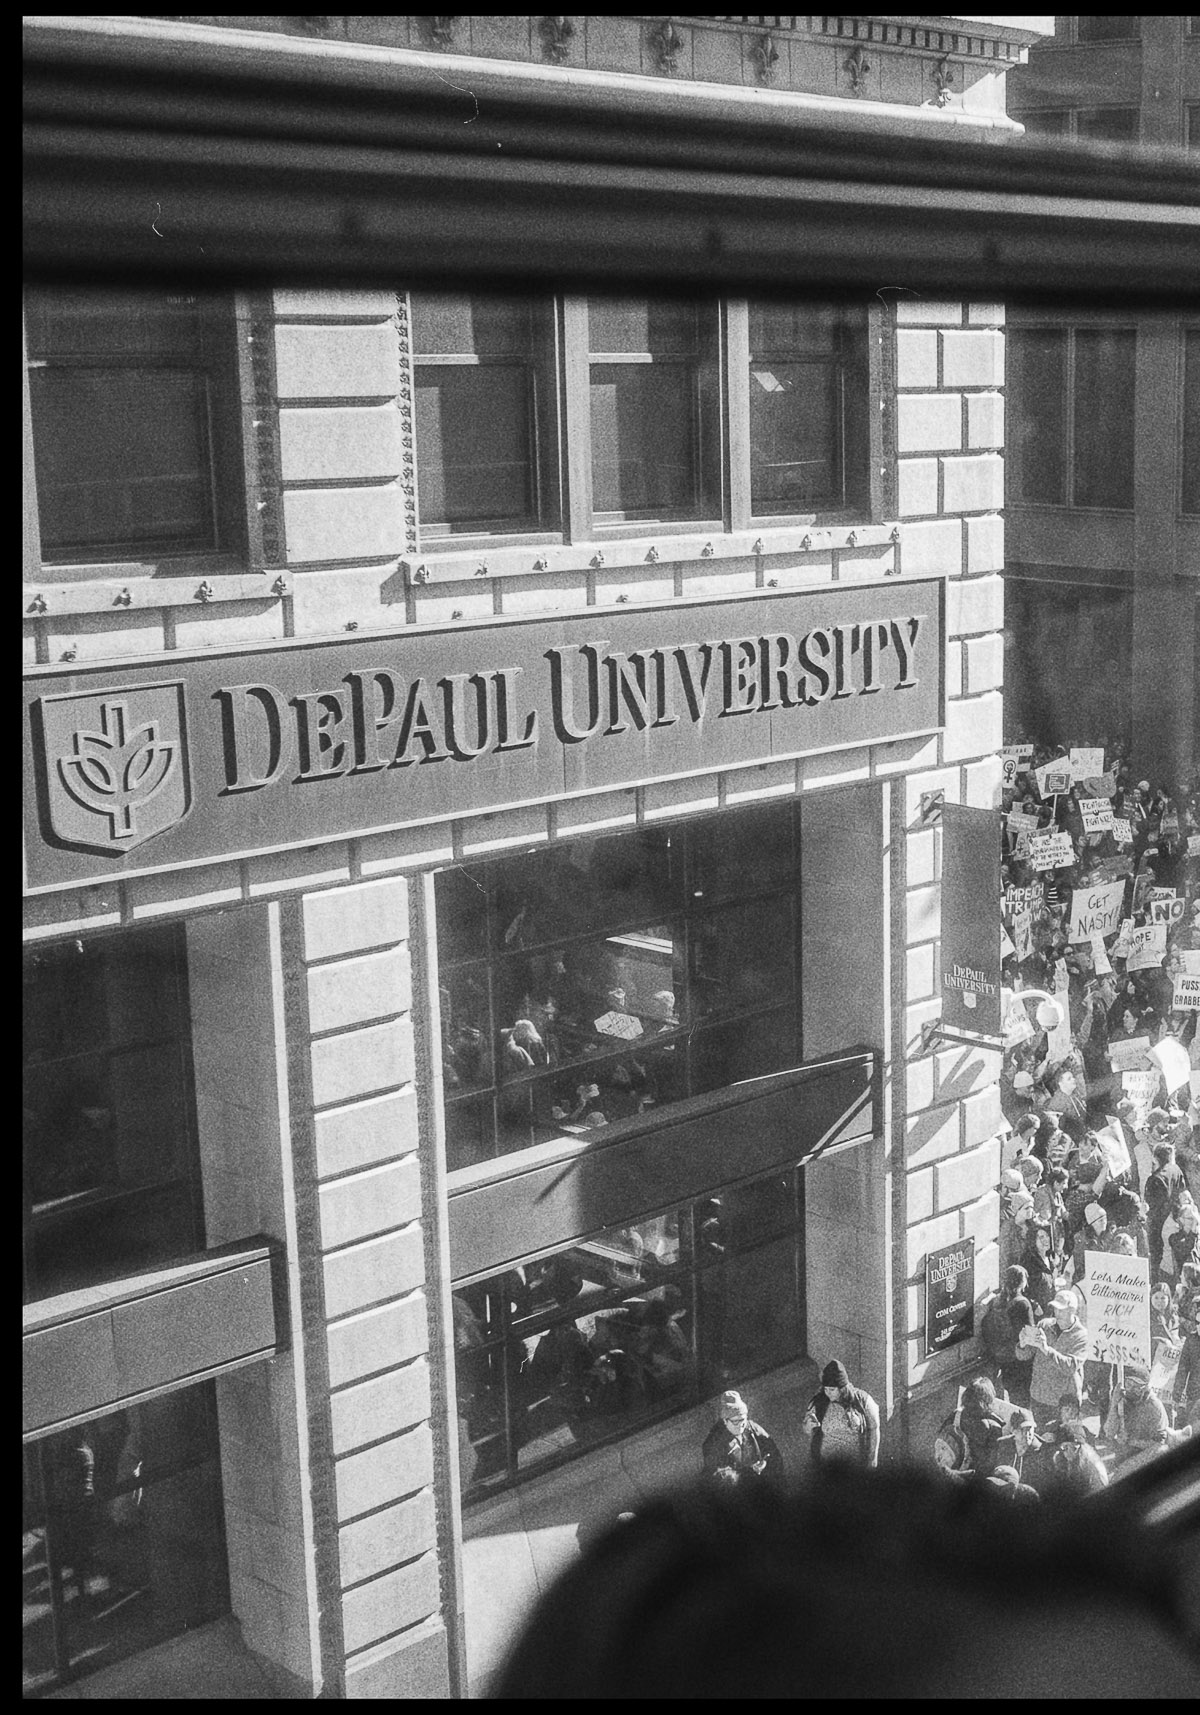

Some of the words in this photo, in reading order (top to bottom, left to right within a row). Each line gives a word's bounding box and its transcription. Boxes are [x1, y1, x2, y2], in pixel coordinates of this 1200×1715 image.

[544, 616, 924, 743] UNIVERSITY
[1007, 883, 1044, 901] IMPEACH
[1006, 897, 1042, 913] TRUMP
[1088, 894, 1110, 910] GET
[1155, 900, 1184, 921] NO
[1130, 931, 1151, 949] HOPE
[953, 964, 986, 983] DEPAUL
[944, 972, 996, 995] UNIVERSITY
[939, 1251, 964, 1269] DEPAUL
[931, 1257, 972, 1282] UNIVERSITY
[1115, 1274, 1147, 1288] Make
[1090, 1283, 1145, 1304] Billionaires
[1104, 1304, 1135, 1317] RICH
[1098, 1323, 1138, 1340] Again
